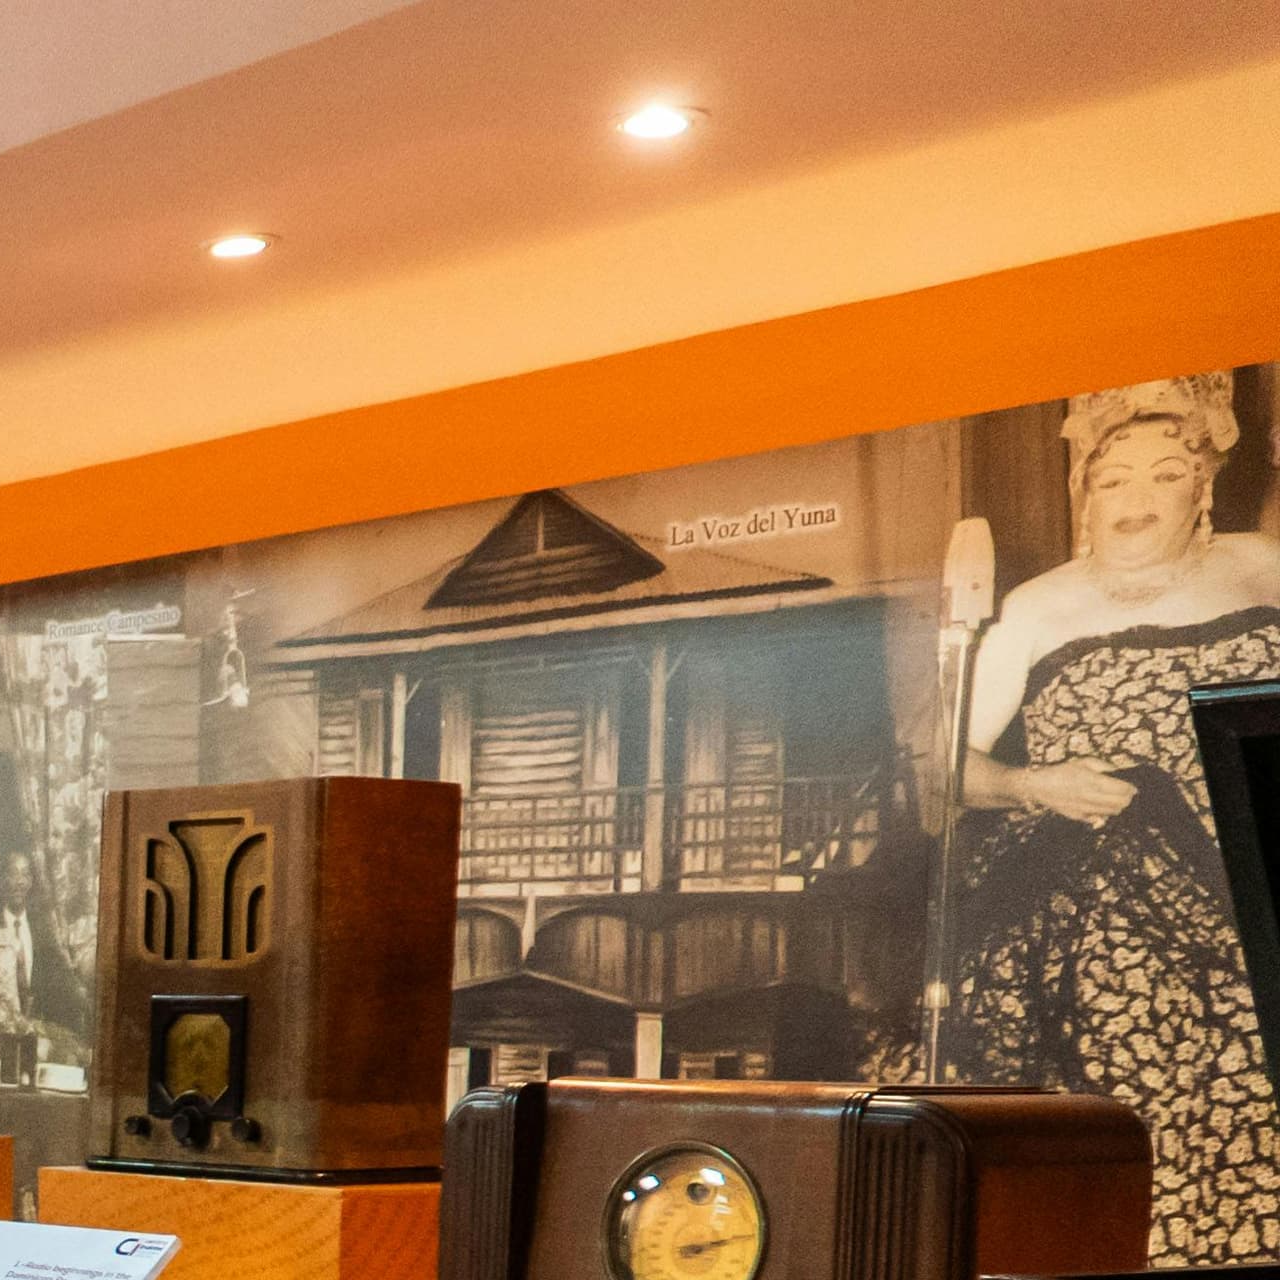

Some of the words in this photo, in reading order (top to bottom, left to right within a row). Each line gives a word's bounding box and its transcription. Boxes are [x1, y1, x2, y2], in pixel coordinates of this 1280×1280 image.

[669, 525, 695, 547] La
[702, 519, 741, 540] Voz
[747, 511, 776, 535] del
[783, 505, 837, 529] Yuna
[48, 620, 103, 640] Romance
[106, 607, 178, 633] Campesino
